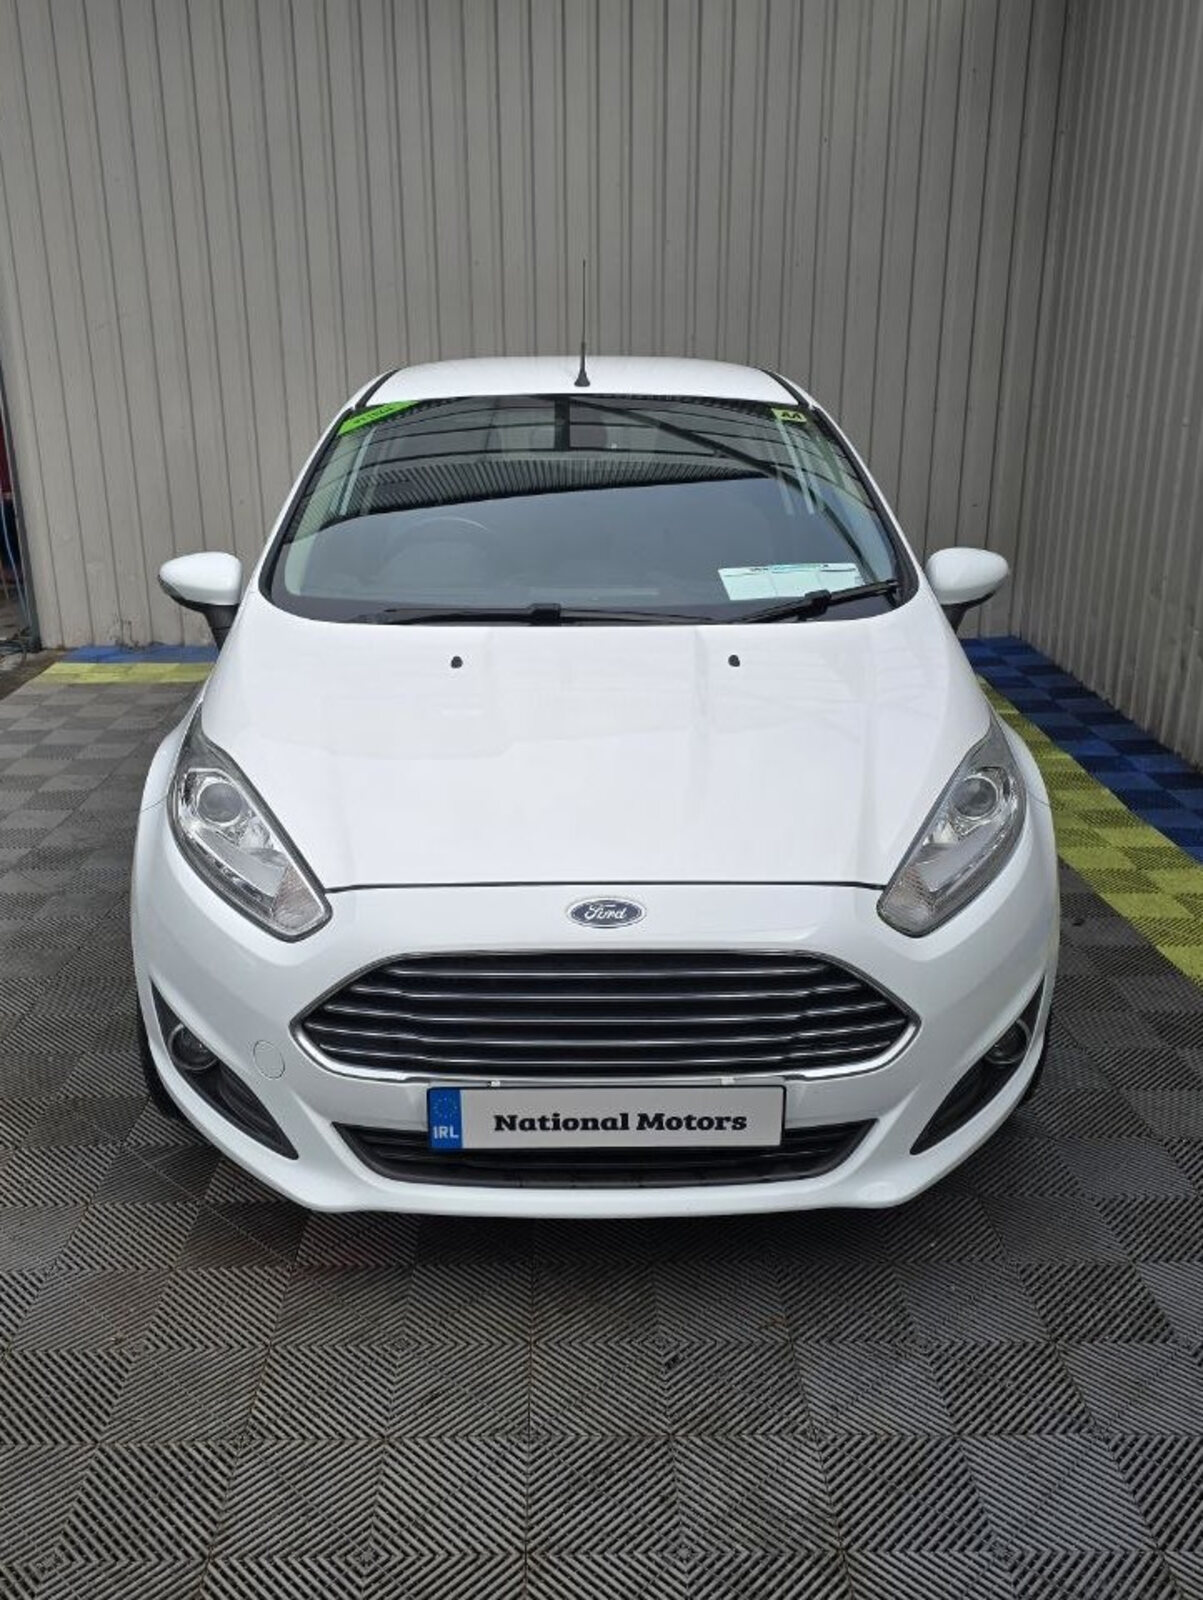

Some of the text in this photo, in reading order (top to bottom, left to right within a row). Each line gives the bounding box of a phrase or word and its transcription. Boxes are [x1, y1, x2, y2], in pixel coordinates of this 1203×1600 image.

[584, 904, 628, 920] Ford
[493, 1112, 748, 1132] National Motors
[432, 1125, 460, 1140] IRL
